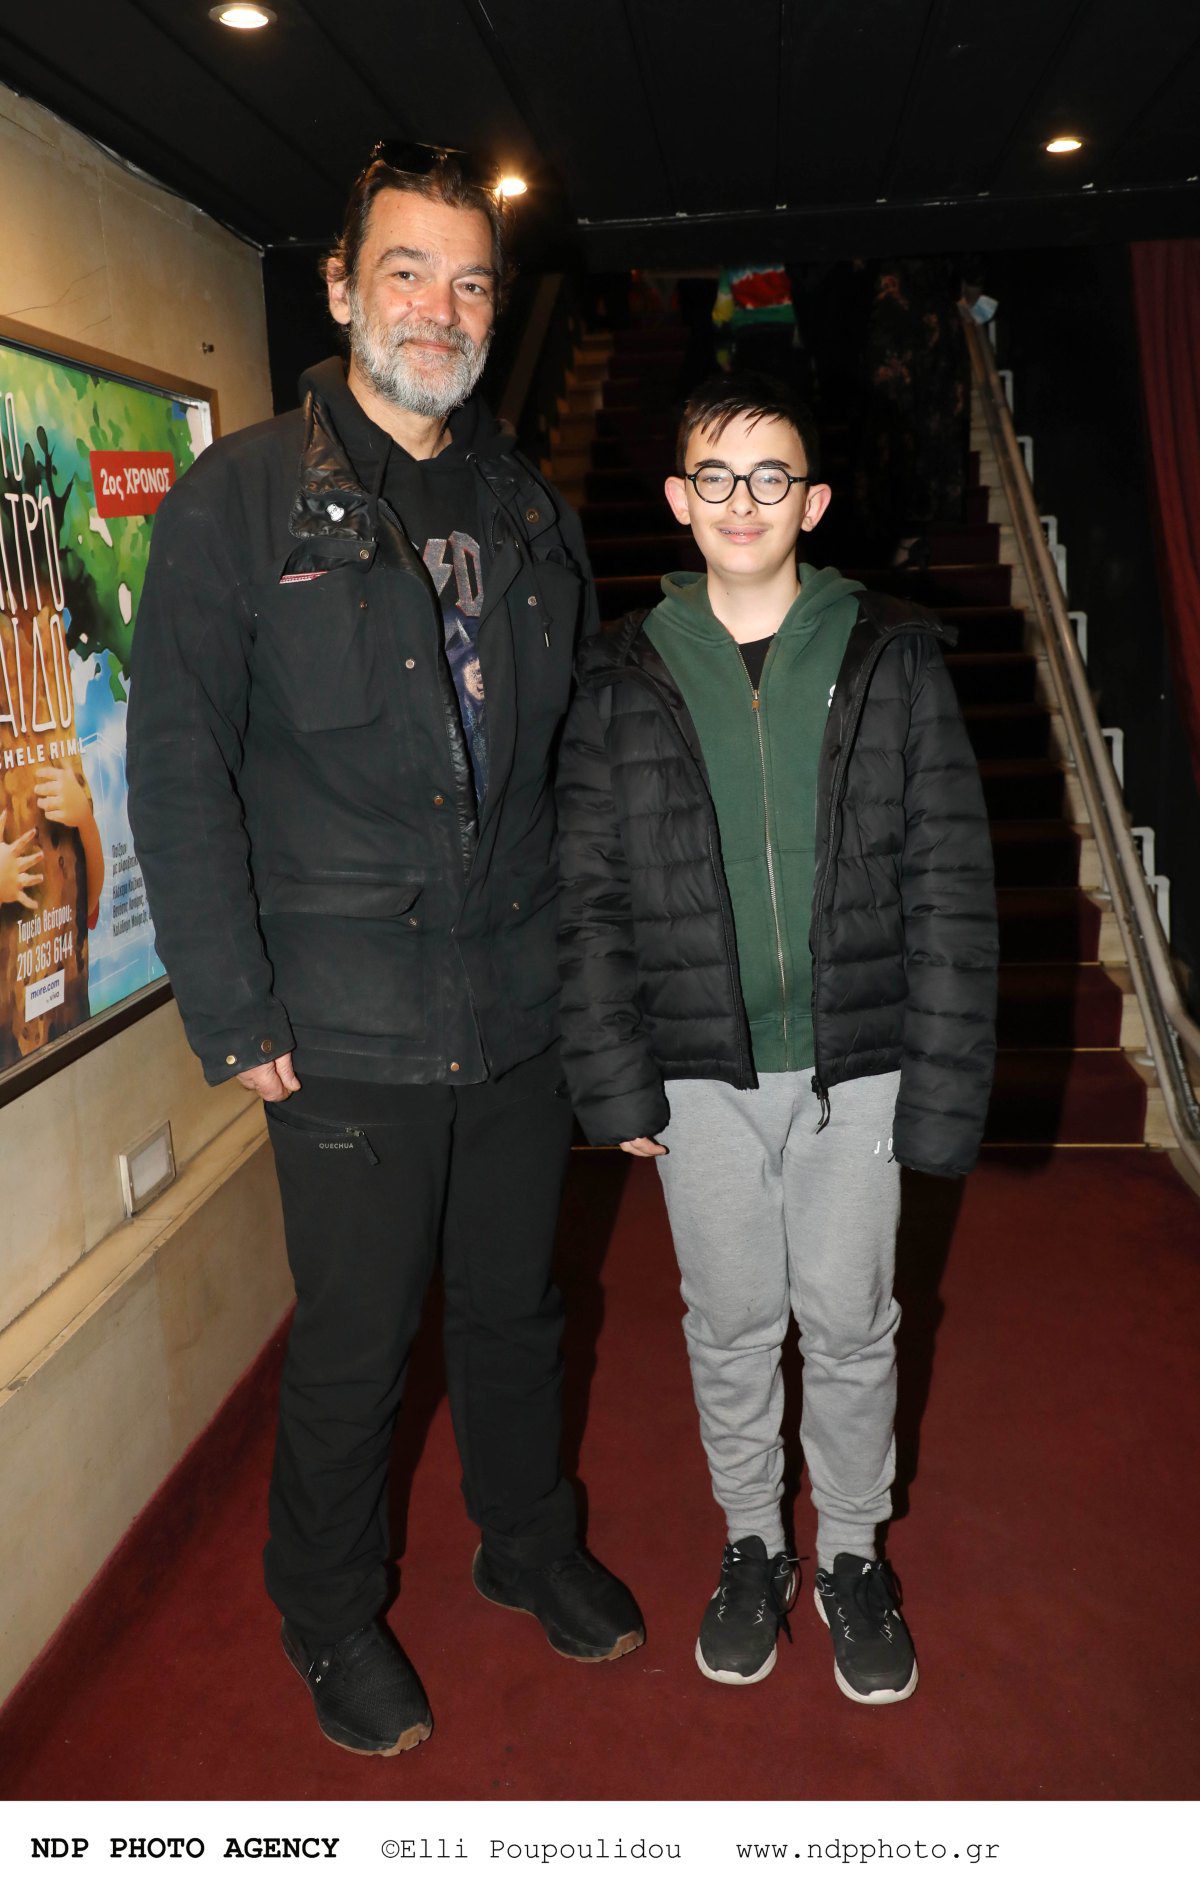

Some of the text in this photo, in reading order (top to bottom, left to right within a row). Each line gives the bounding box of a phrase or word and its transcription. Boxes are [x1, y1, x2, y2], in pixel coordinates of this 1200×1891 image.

[123, 467, 171, 494] ΧΡΟΝΟΣ
[16, 930, 73, 981] 210 363 6144
[30, 979, 60, 1000] more.com
